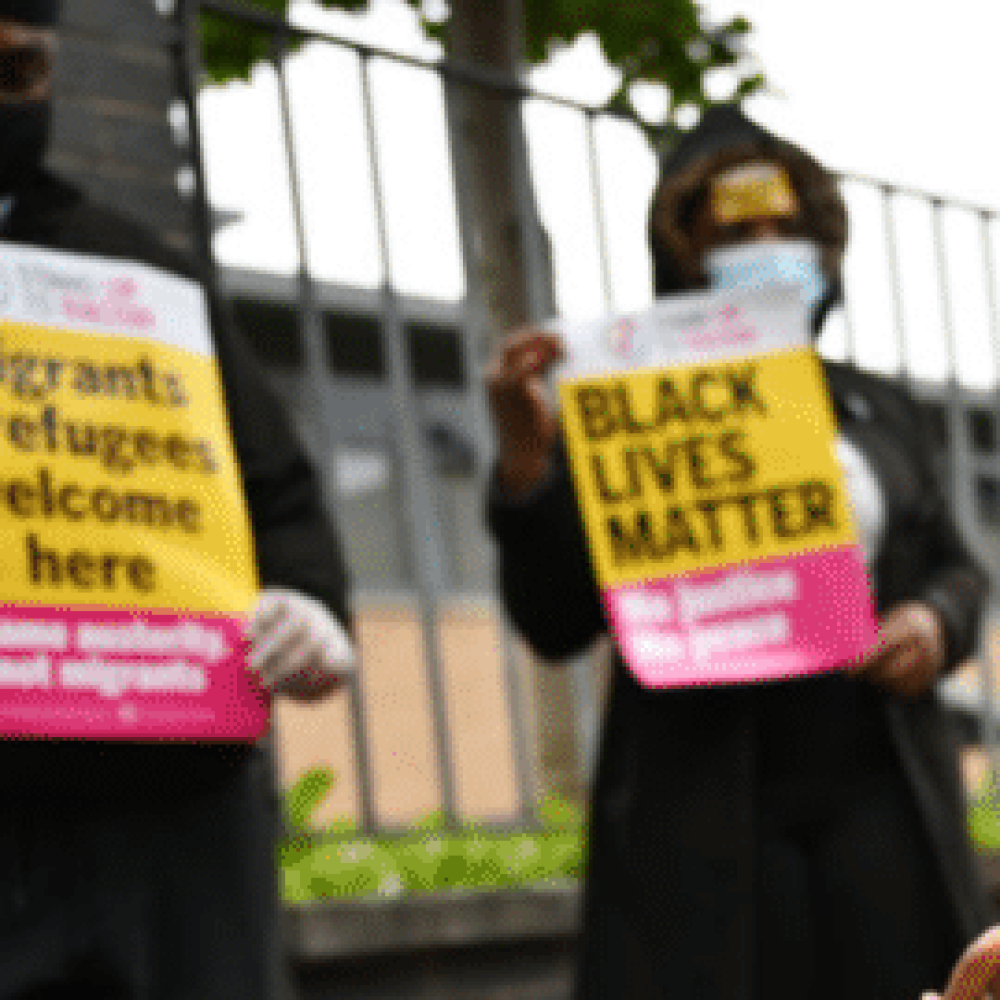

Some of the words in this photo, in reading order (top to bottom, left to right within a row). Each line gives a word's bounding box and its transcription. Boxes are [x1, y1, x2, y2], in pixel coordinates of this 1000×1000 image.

[574, 367, 767, 440] BLACK
[0, 406, 217, 475] efugees
[590, 427, 757, 503] LIVES
[0, 466, 203, 533] elcome
[607, 480, 838, 568] MATTER
[23, 531, 157, 594] here
